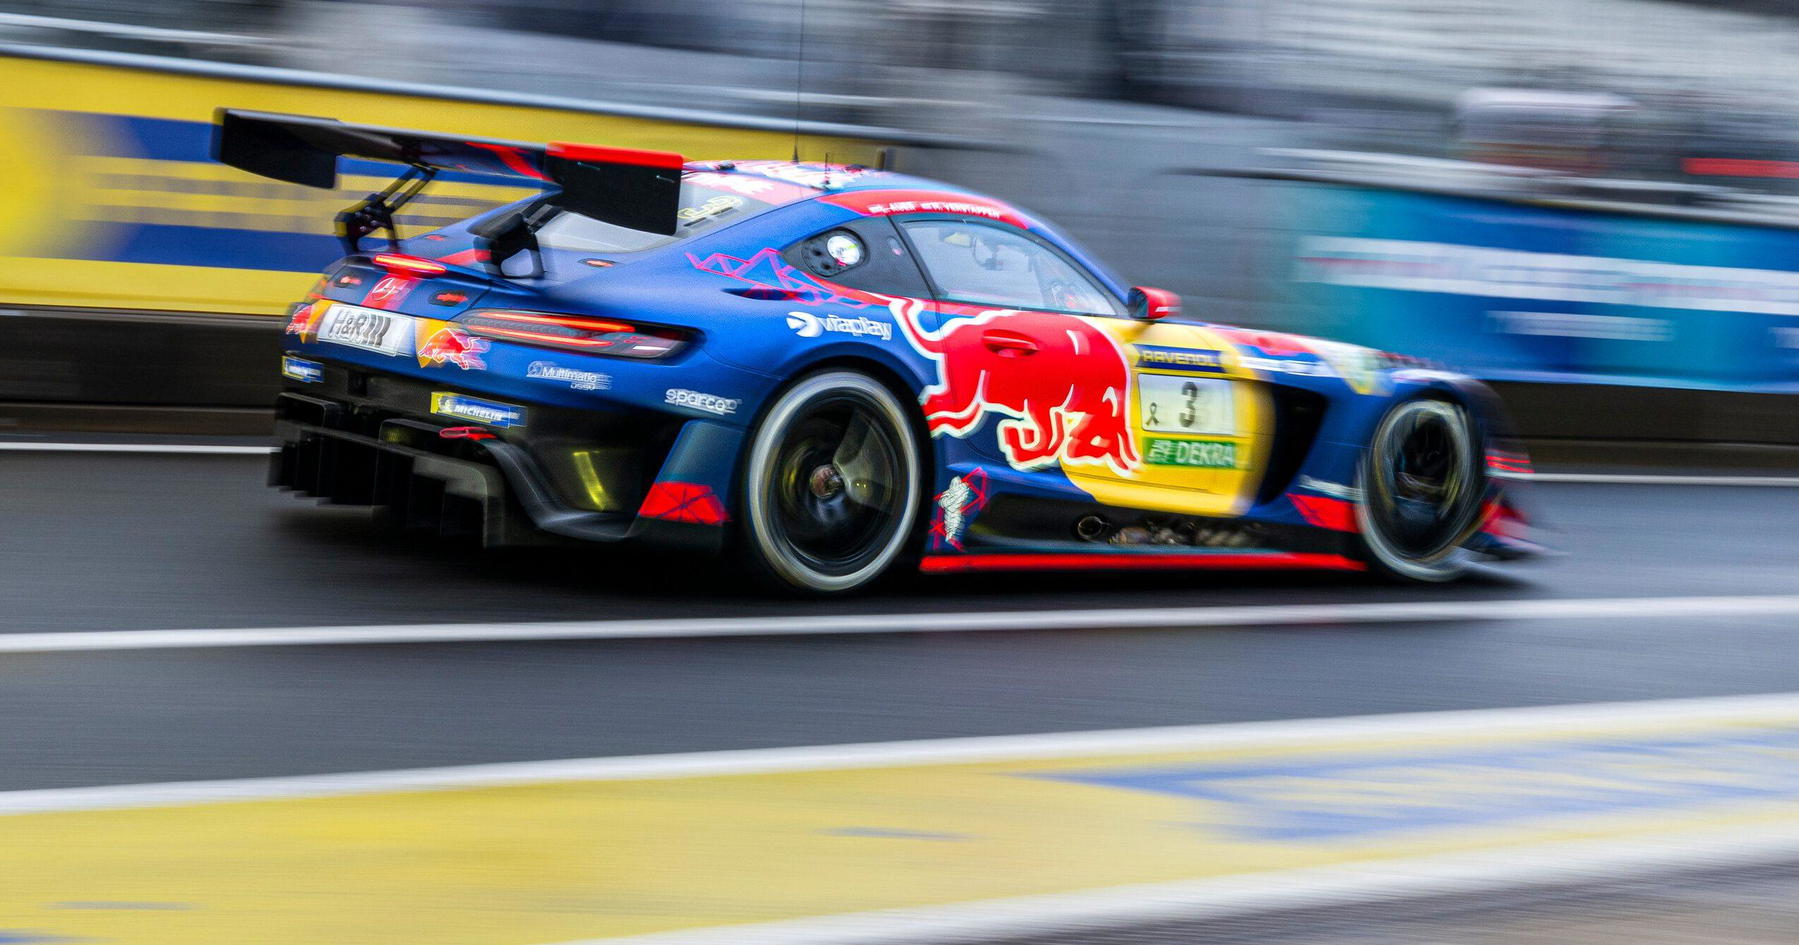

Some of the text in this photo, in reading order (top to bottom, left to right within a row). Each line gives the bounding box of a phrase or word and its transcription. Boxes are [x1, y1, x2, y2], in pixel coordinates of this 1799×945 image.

[817, 314, 892, 341] viaplay
[454, 404, 507, 421] MICHELIN
[665, 388, 737, 413] sparco
[1179, 381, 1199, 428] 3
[1175, 441, 1234, 466] DEKRA
